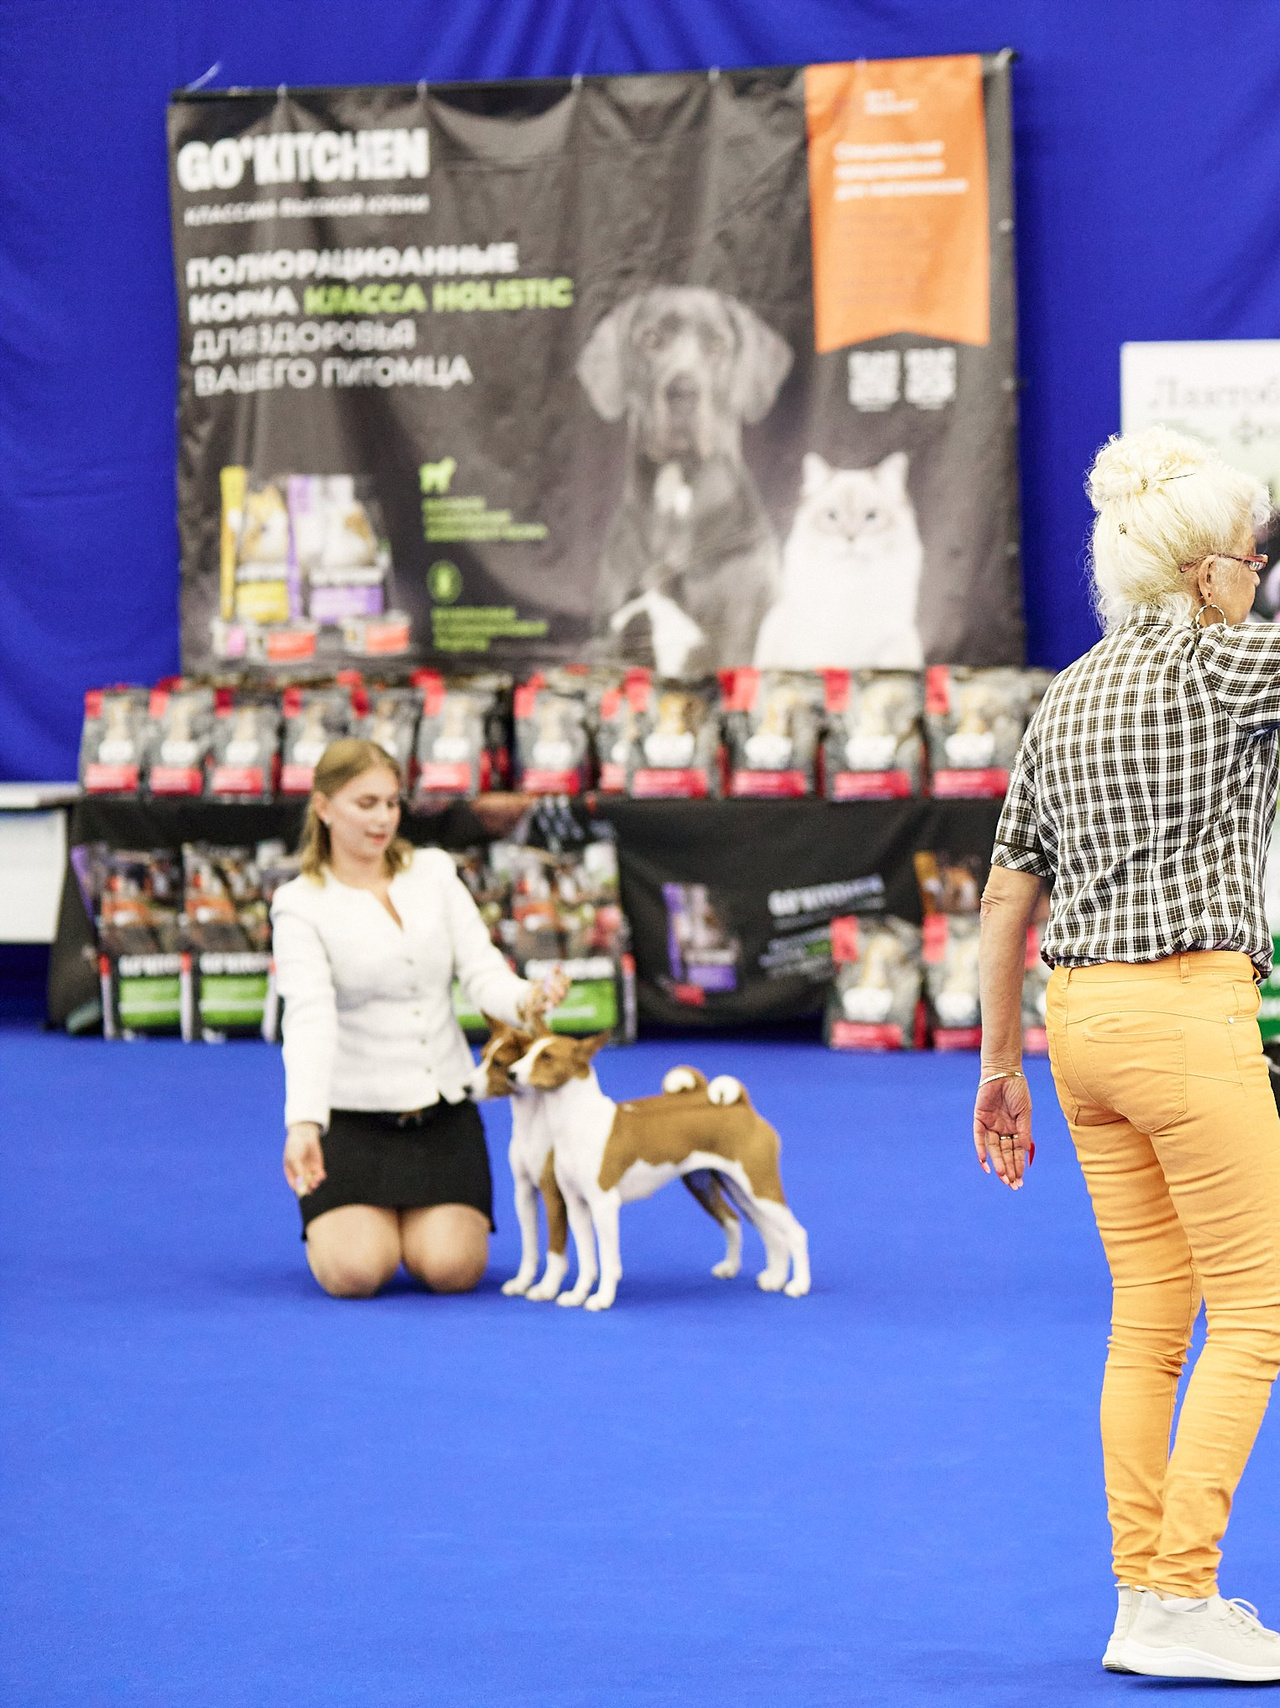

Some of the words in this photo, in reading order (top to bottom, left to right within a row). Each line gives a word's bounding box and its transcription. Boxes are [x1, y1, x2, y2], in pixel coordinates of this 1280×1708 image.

[432, 276, 574, 313] HOLISTIC
[194, 357, 317, 397] ВАШЕГО
[321, 354, 474, 390] ПИТОМЦА
